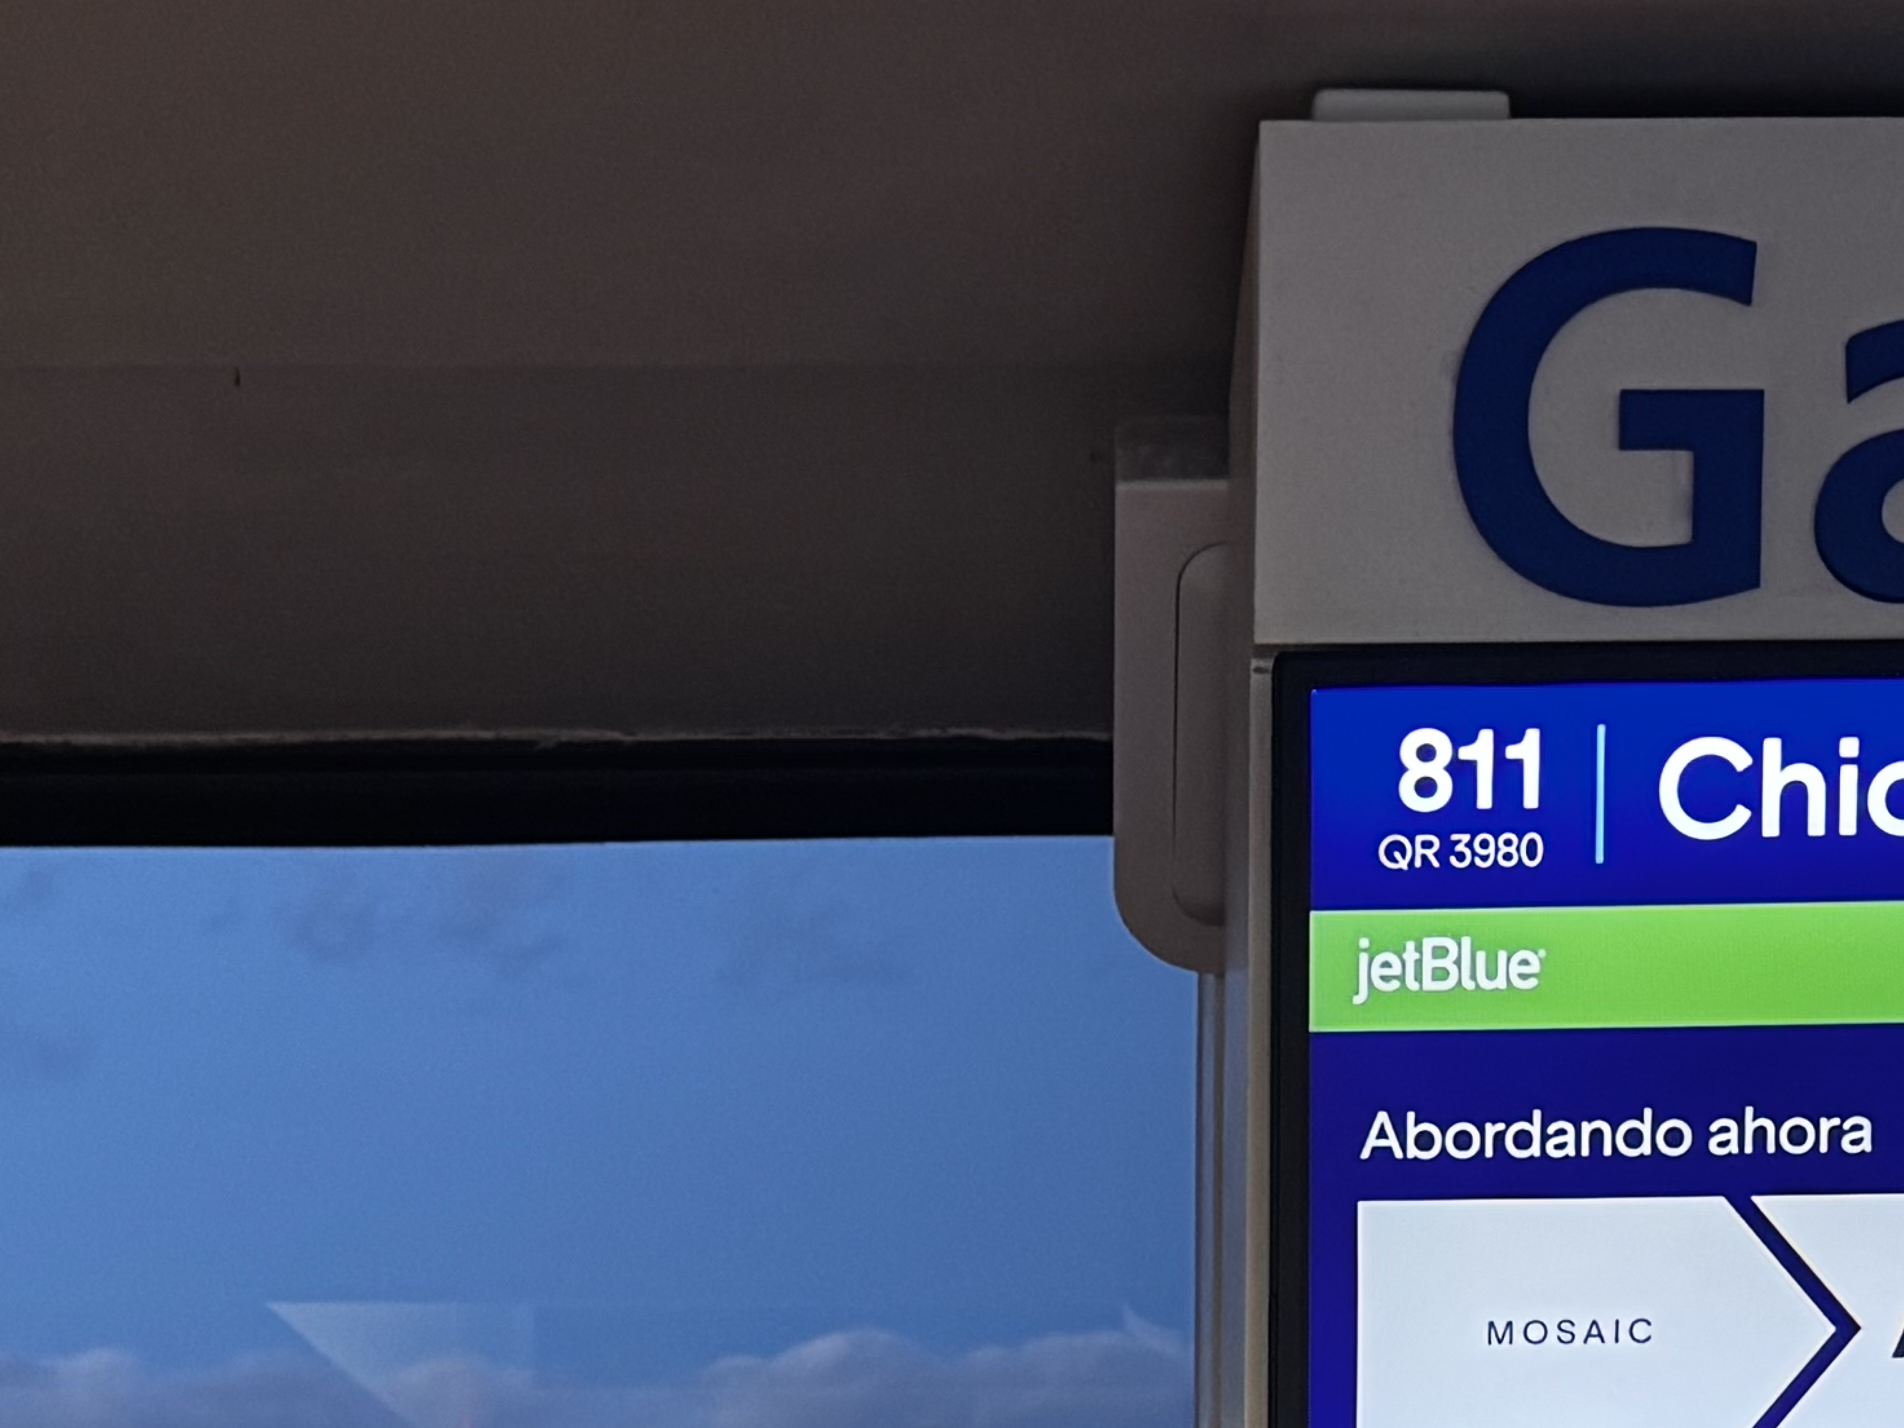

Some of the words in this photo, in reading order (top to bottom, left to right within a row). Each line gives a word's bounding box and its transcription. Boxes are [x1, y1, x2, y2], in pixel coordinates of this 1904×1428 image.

[1399, 728, 1540, 812] 811
[1379, 835, 1440, 870] QR
[1450, 832, 1543, 868] 3980
[1353, 936, 1538, 1004] jetBlue
[1360, 1108, 1692, 1159] Abordando
[1709, 1106, 1871, 1155] ahora
[1488, 1319, 1651, 1345] MOSAIC
